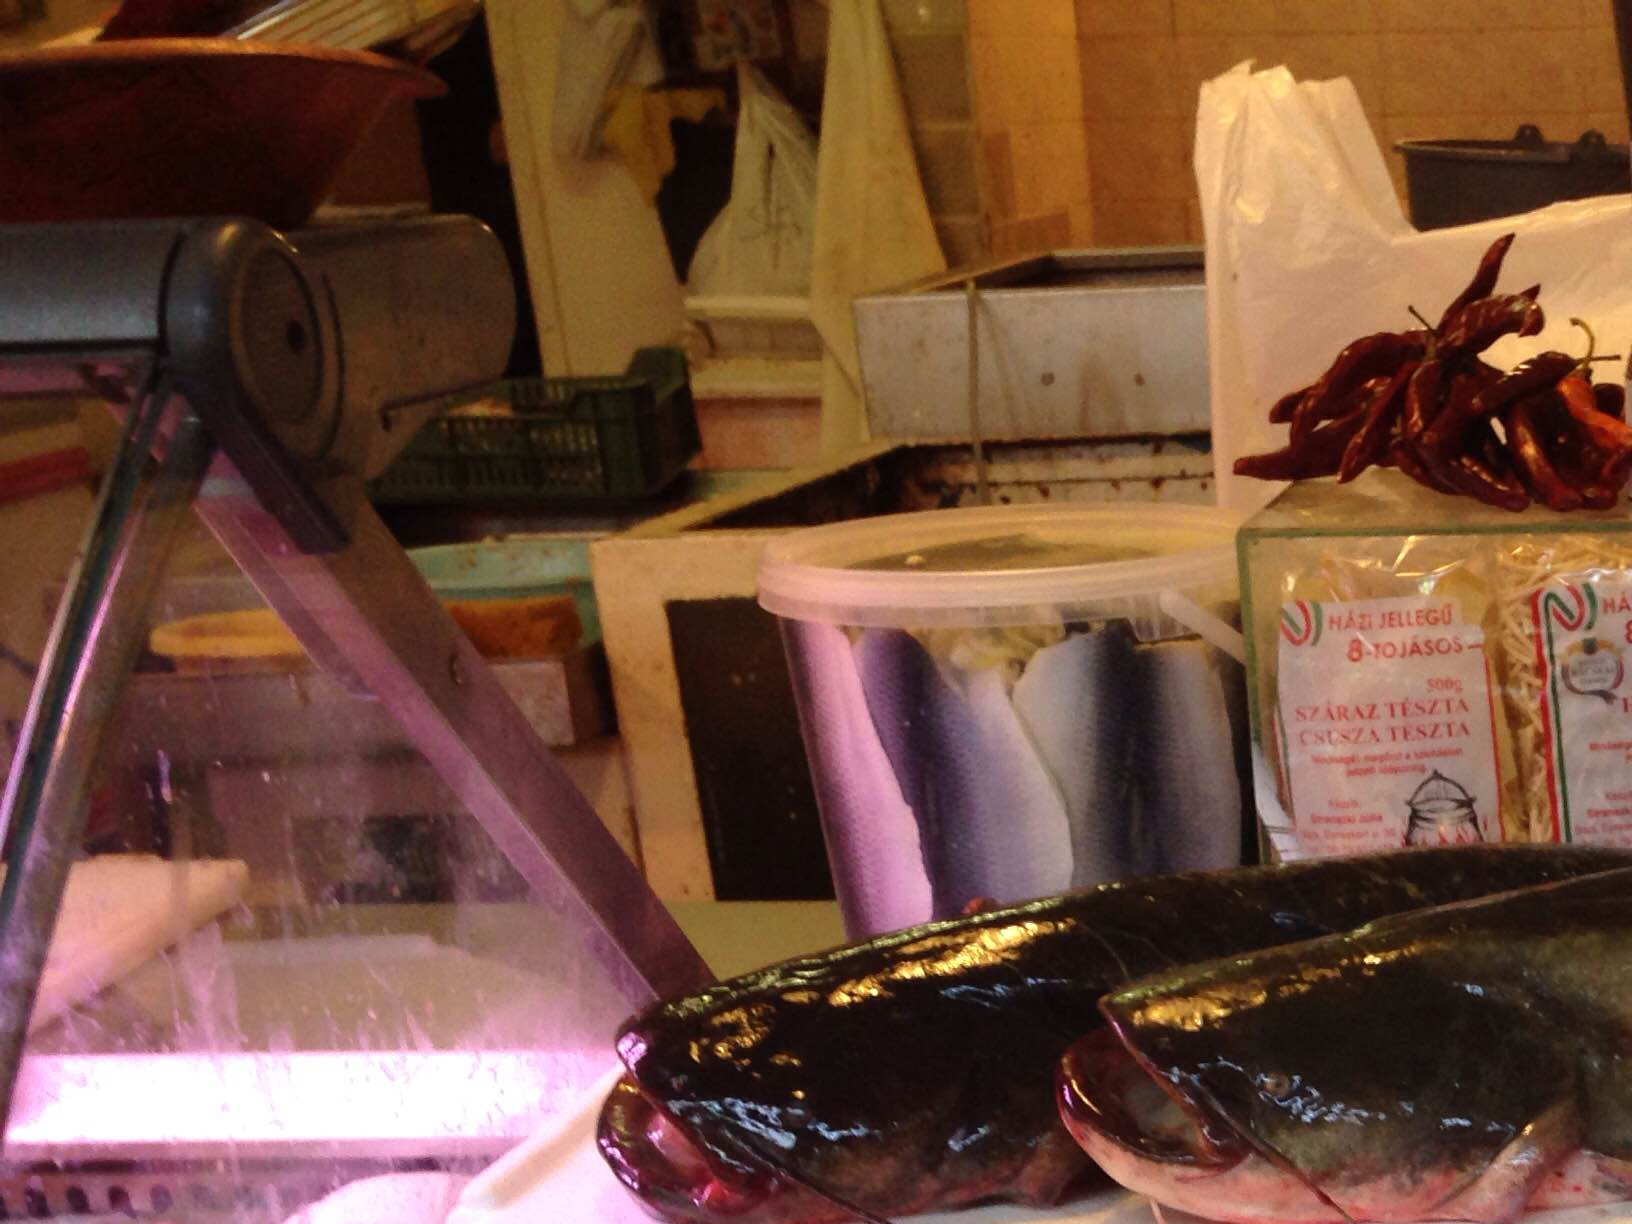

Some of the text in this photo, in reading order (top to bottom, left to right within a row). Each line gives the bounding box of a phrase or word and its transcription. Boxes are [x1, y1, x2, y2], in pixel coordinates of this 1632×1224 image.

[1327, 609, 1374, 631] HÁZI
[1345, 634, 1463, 663] 8-TOJÁSOS
[1295, 702, 1380, 722] SZÁRAZ
